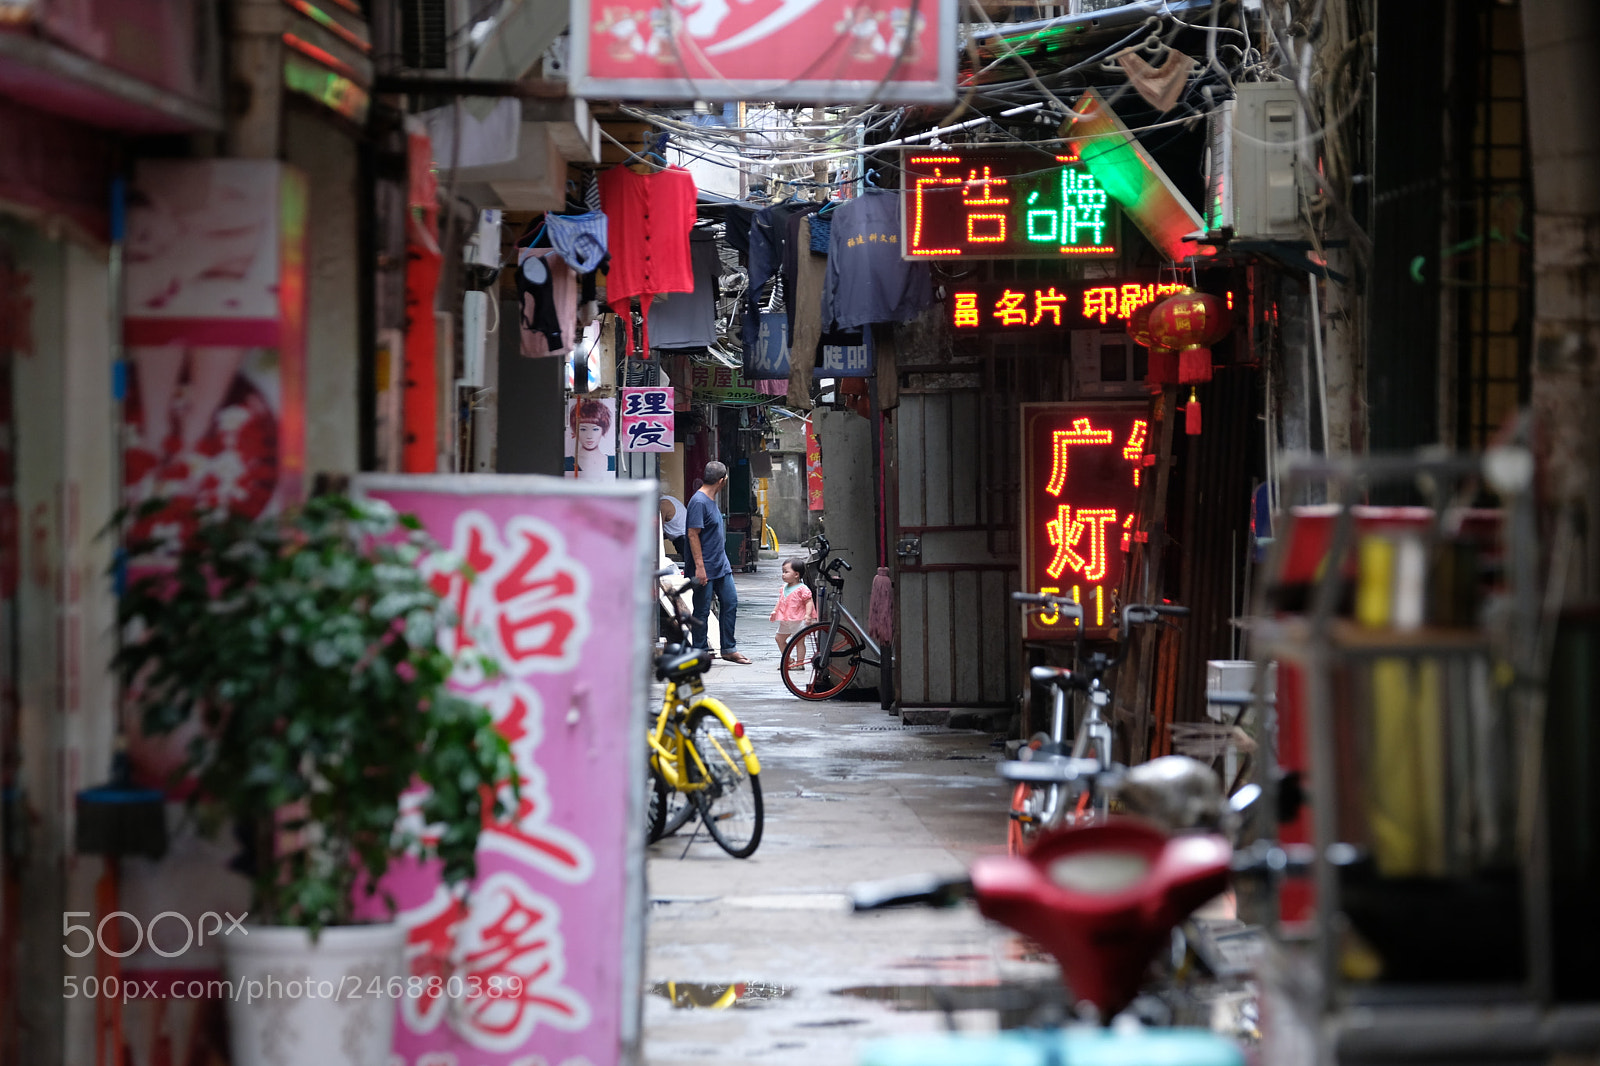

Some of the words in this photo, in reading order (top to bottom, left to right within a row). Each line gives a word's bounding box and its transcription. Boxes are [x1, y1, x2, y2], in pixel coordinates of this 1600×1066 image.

[992, 286, 1068, 327] 名片
[1082, 283, 1156, 325] 印刷
[750, 321, 868, 370] 成人健品
[624, 391, 674, 450] 理发
[1045, 503, 1135, 581] 灯
